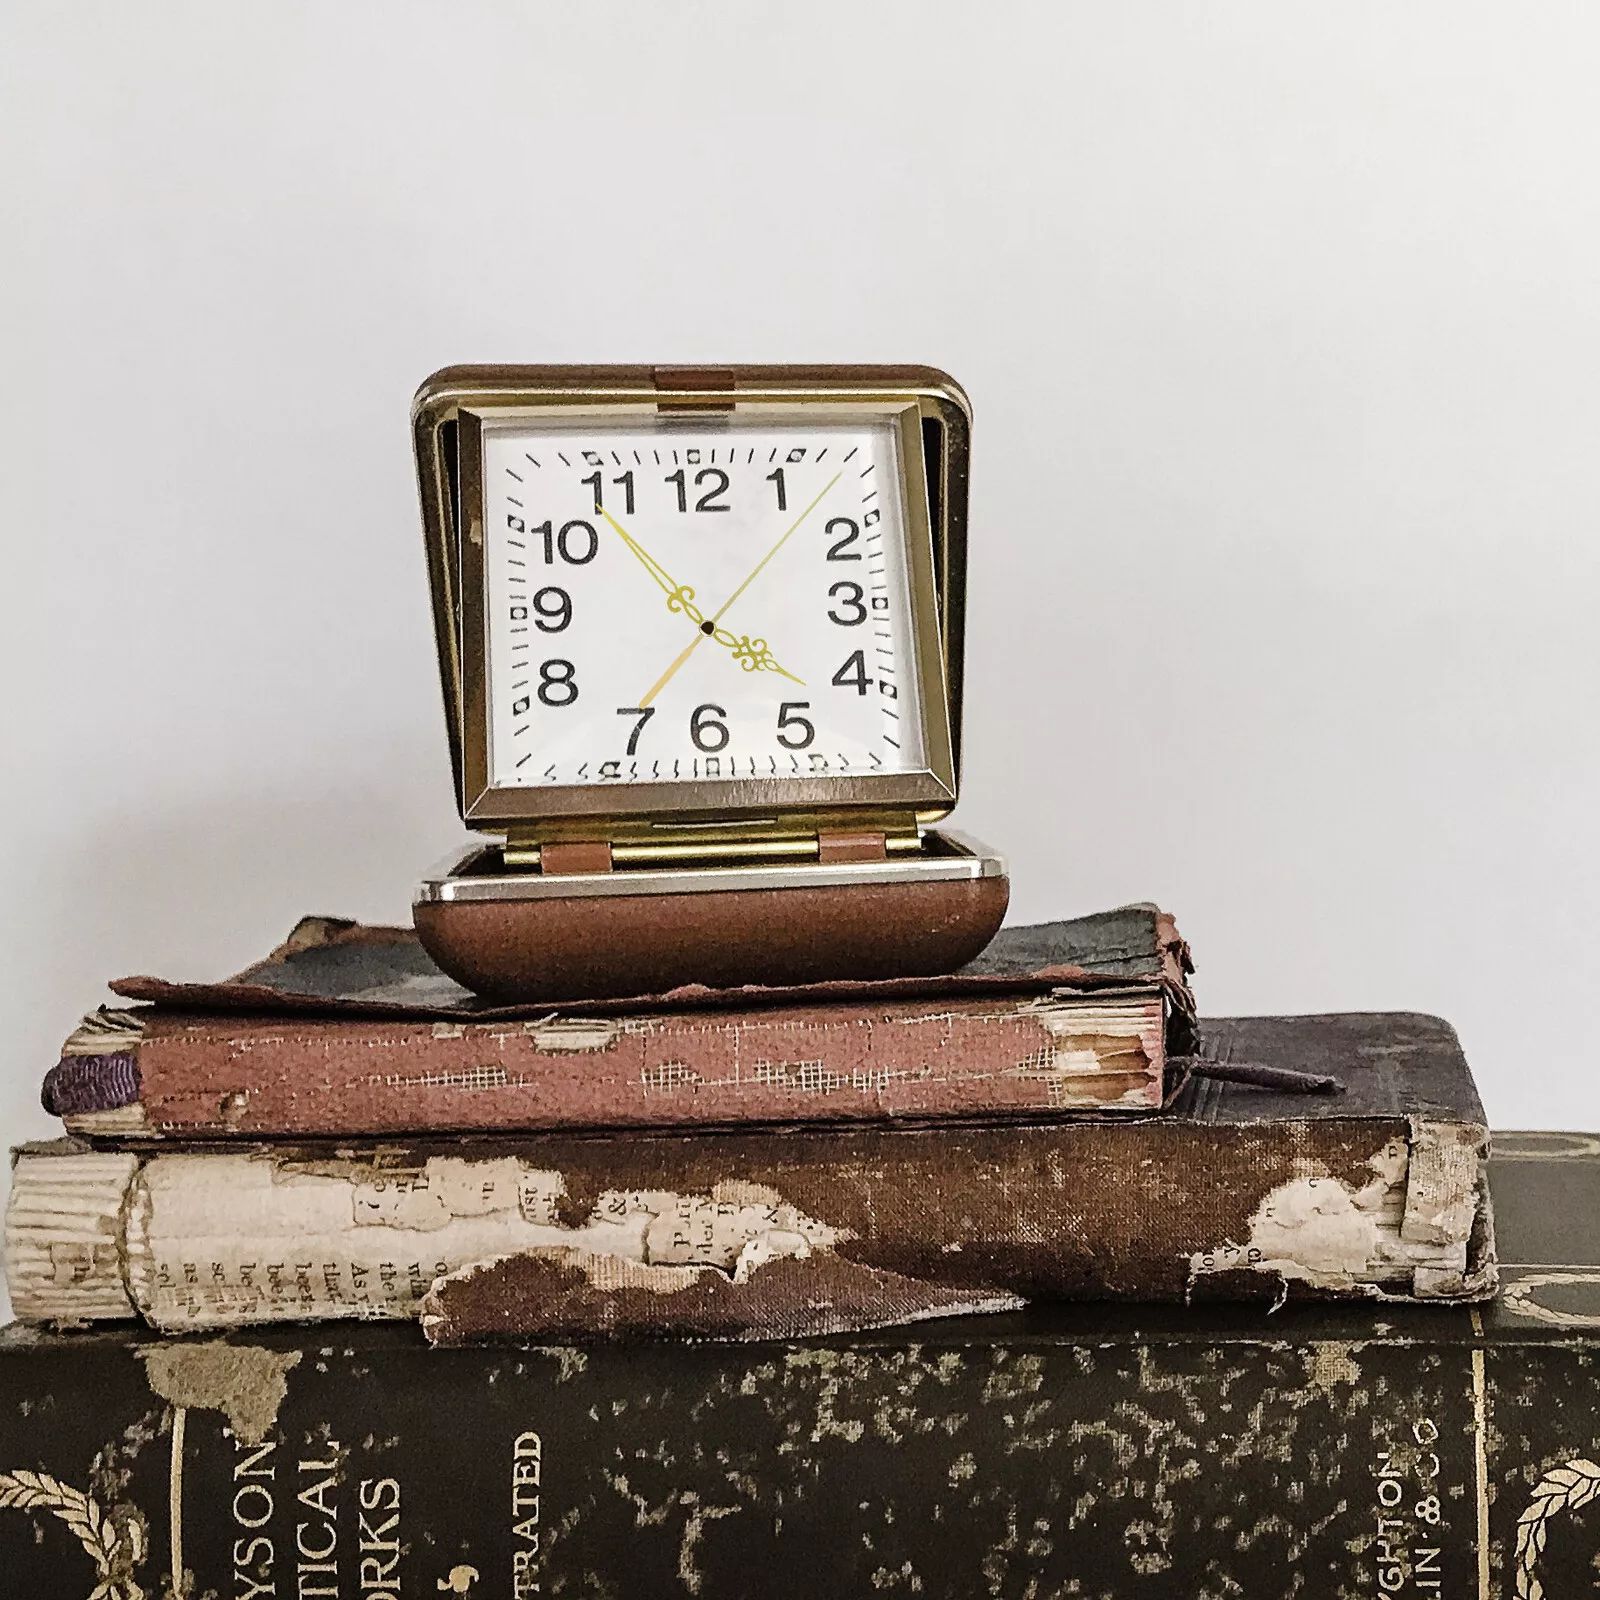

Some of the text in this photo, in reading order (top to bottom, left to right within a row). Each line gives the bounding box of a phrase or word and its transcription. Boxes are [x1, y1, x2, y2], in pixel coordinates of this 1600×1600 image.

[581, 471, 636, 515] 11
[664, 468, 731, 513] 12
[766, 467, 787, 512] 1
[531, 519, 599, 565] 10
[824, 517, 863, 562] 2
[533, 586, 573, 634] 9
[827, 581, 869, 627] 3
[537, 659, 579, 707] 8
[831, 650, 874, 697] 4
[616, 707, 656, 757] 7
[689, 704, 730, 753] 6
[776, 702, 816, 750] 5
[359, 1478, 401, 1600] RKS
[1376, 1452, 1404, 1600] GHTON
